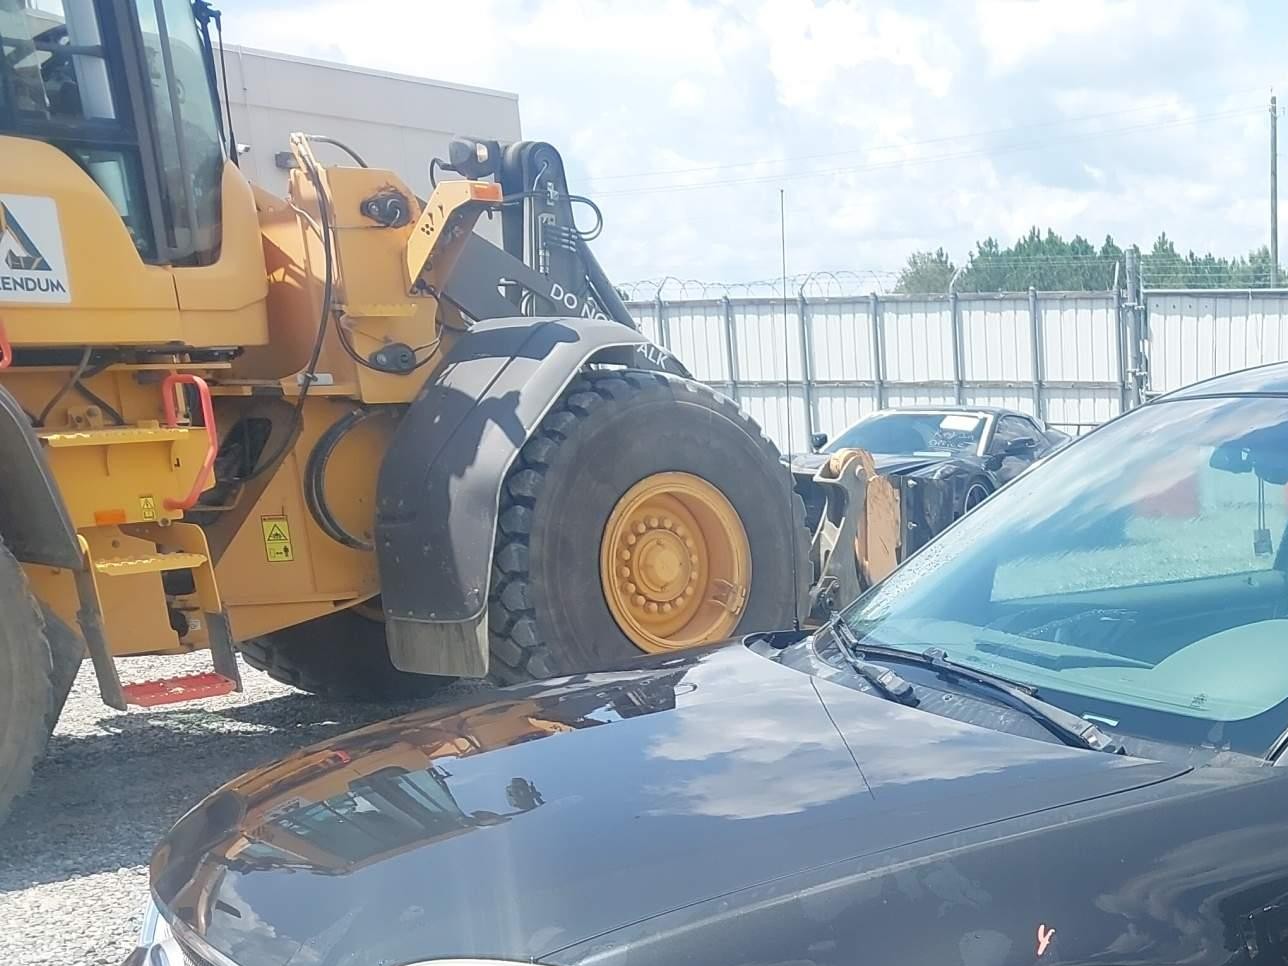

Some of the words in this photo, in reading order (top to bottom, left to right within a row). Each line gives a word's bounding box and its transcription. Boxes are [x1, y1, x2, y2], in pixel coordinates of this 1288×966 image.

[0, 276, 66, 293] ENDUM
[550, 283, 577, 309] DO
[637, 343, 668, 370] ALK
